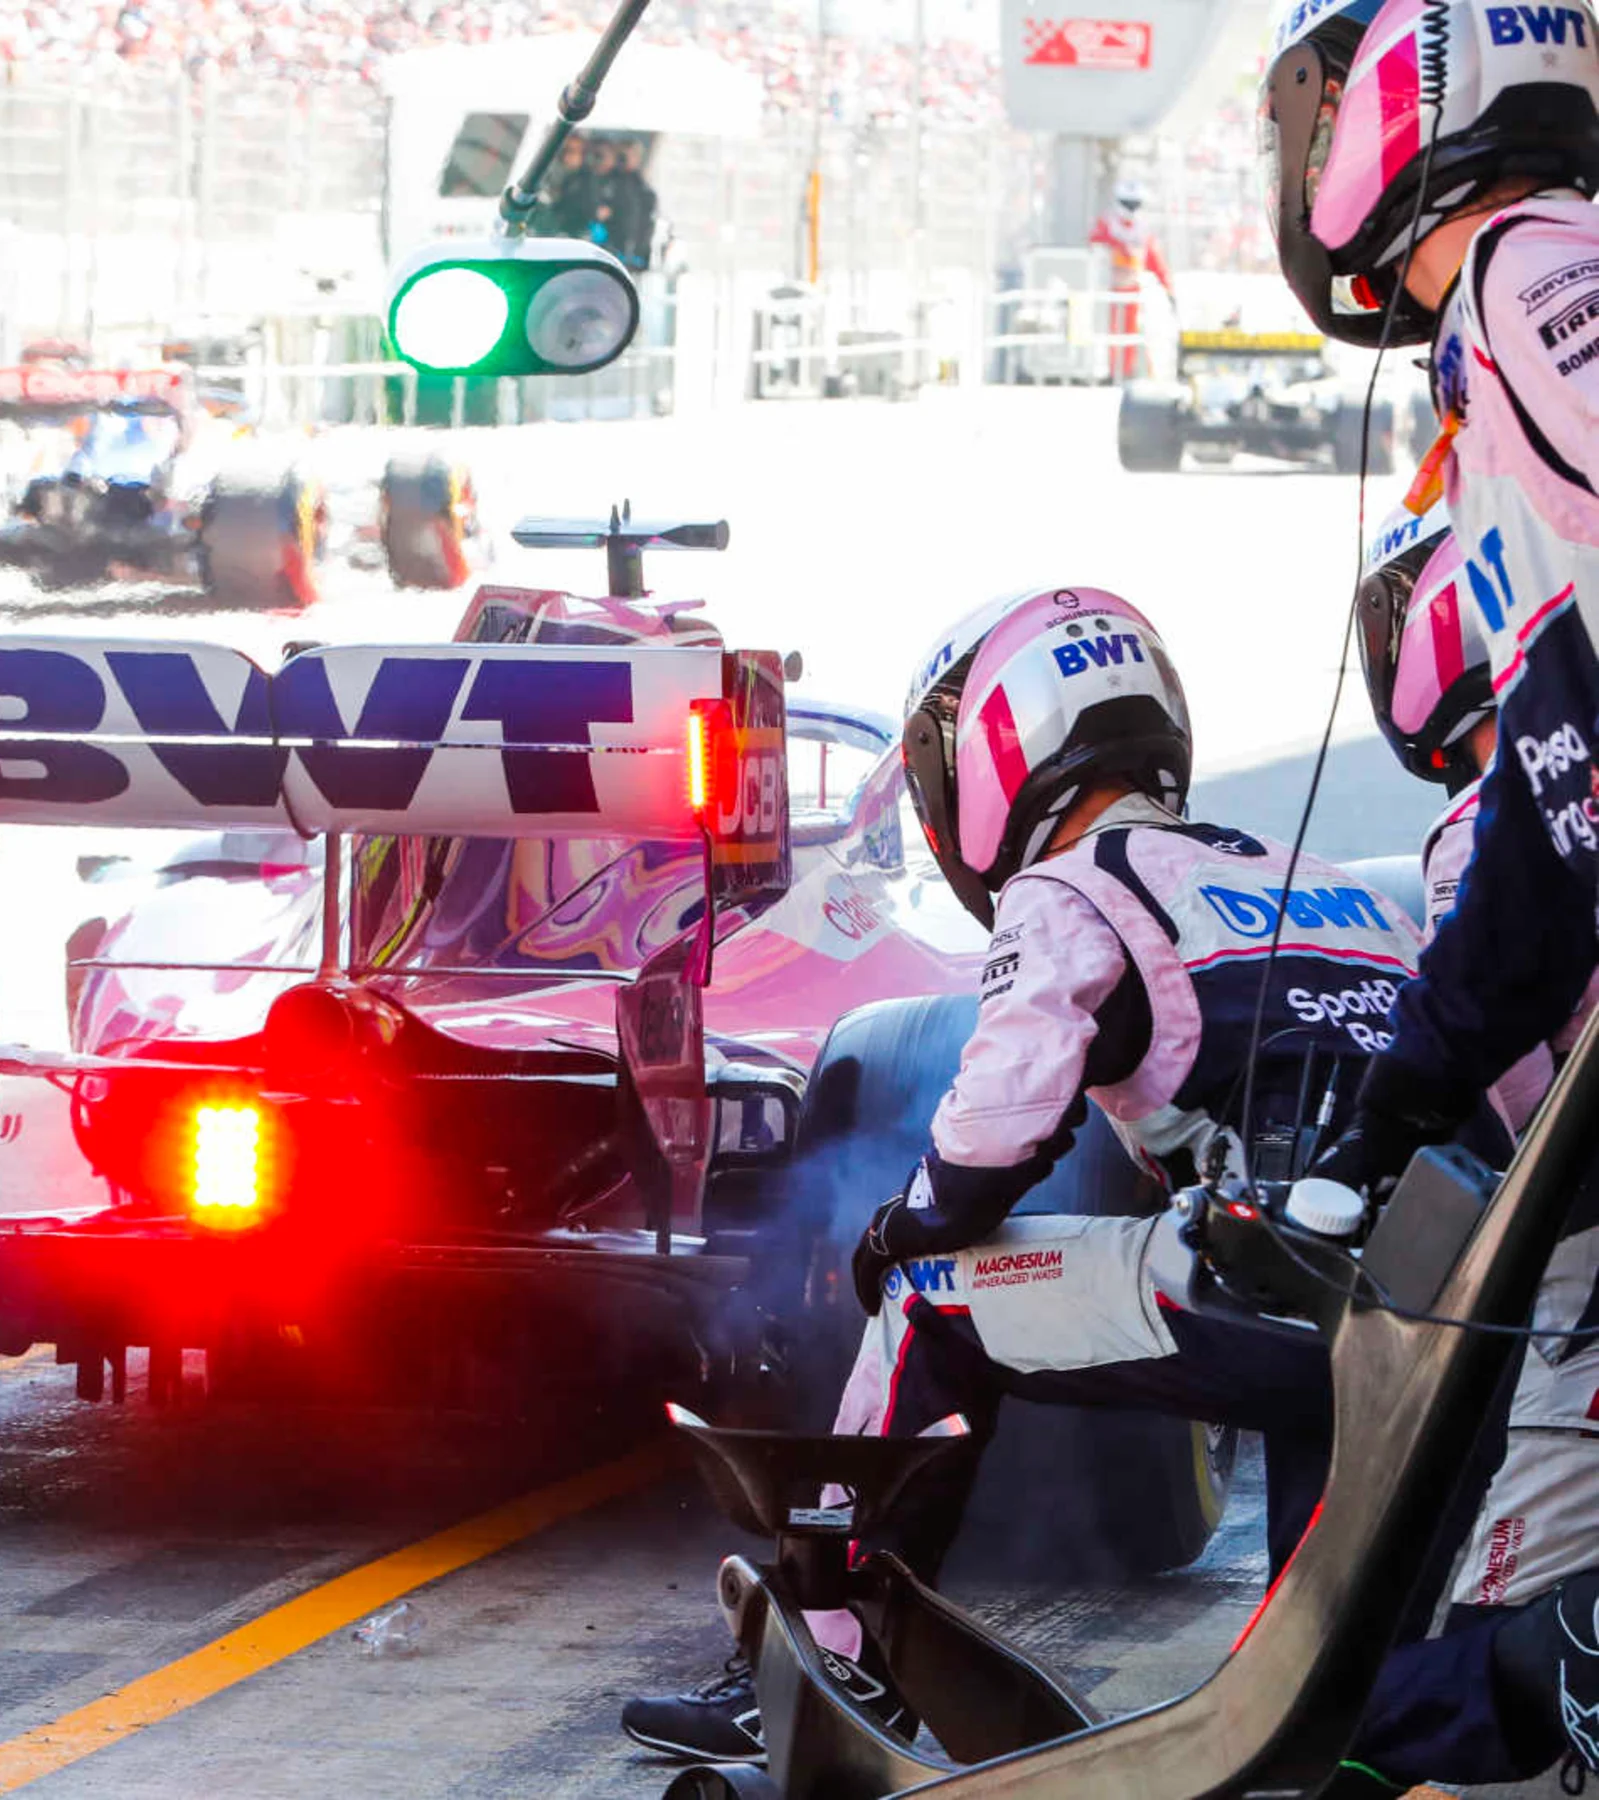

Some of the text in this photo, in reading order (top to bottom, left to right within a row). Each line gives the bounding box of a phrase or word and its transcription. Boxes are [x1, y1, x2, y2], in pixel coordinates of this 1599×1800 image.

[1486, 6, 1588, 48] BWT
[1053, 634, 1144, 678] BWT
[1274, 886, 1394, 933] BWT
[910, 1258, 957, 1293] WT
[974, 1249, 1064, 1277] MAGNESIUM
